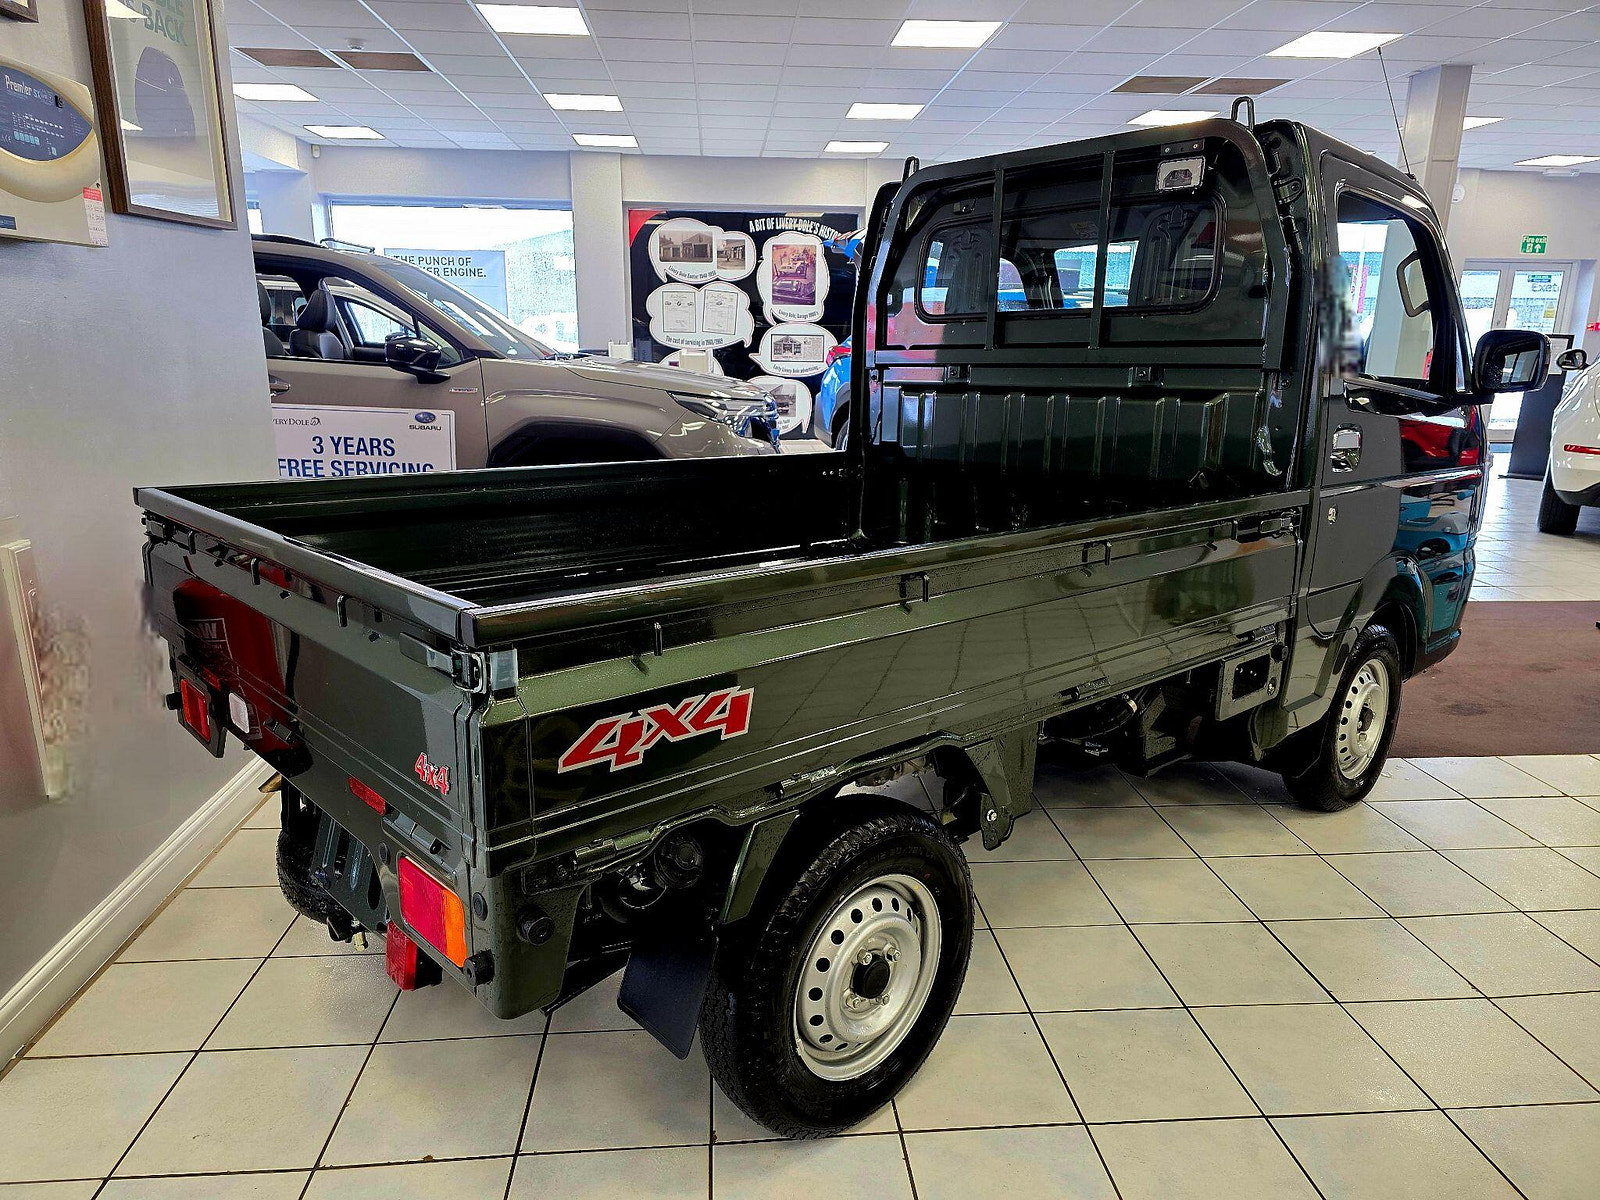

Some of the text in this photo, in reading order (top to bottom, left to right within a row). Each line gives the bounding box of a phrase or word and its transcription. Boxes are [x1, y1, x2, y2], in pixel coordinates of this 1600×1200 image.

[5, 74, 33, 96] Premier
[749, 220, 755, 233] A
[755, 218, 766, 232] BIT
[766, 217, 775, 230] OF
[775, 217, 798, 231] LIVERY
[1522, 236, 1534, 244] Fire
[418, 256, 455, 266] PUNCH
[457, 257, 472, 266] OF
[443, 268, 487, 278] ENGINE.
[1531, 282, 1559, 293] Exet
[288, 418, 310, 426] DOLE
[311, 435, 396, 457] 3 YEARS
[277, 458, 326, 478] FREE
[558, 685, 755, 774] 4x4
[414, 751, 451, 796] 4x4
